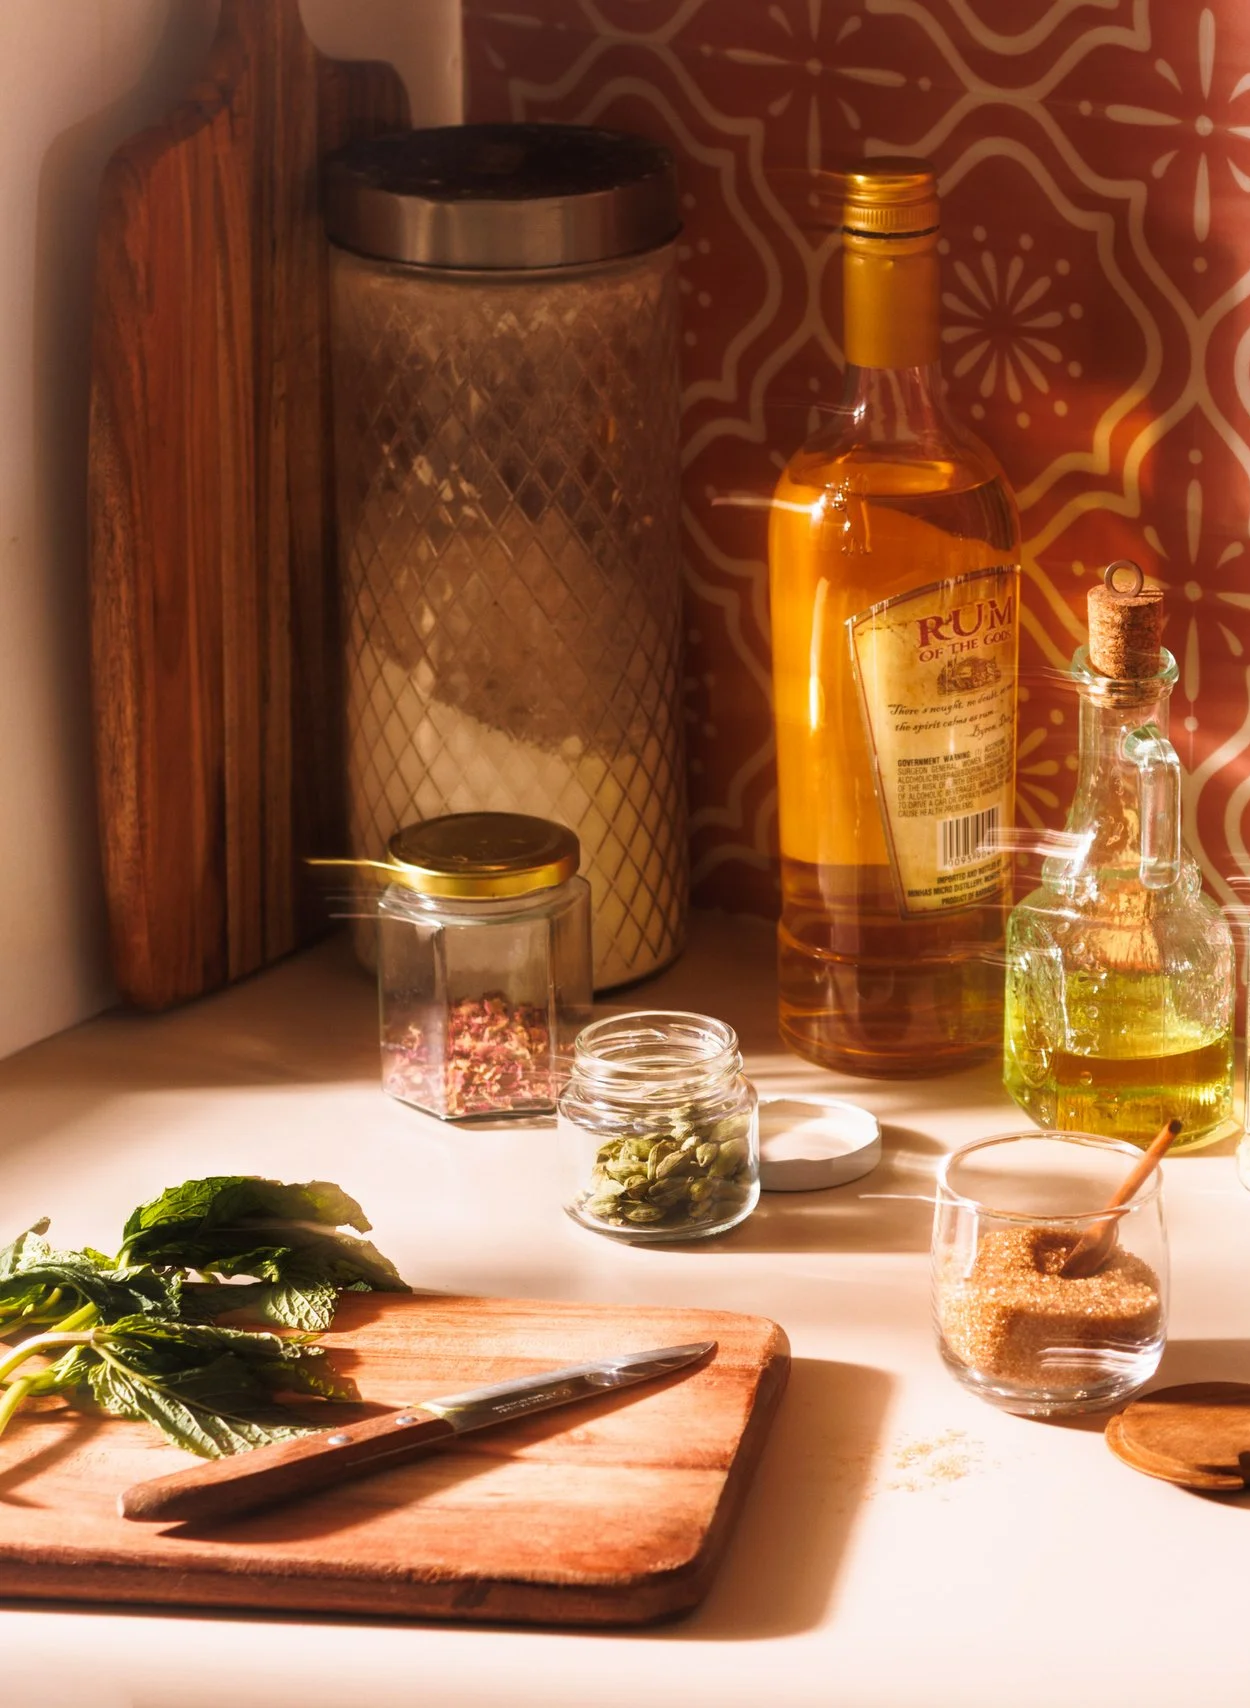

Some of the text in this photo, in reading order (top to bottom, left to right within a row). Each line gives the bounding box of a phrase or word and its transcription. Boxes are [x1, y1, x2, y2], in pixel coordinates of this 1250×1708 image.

[916, 596, 1012, 649] RUM
[919, 630, 1012, 663] OF THE GODS
[895, 720, 911, 732] the
[913, 720, 941, 735] spirit
[943, 715, 968, 727] calms
[969, 714, 979, 722] as
[897, 756, 940, 767] GOVERNMENT
